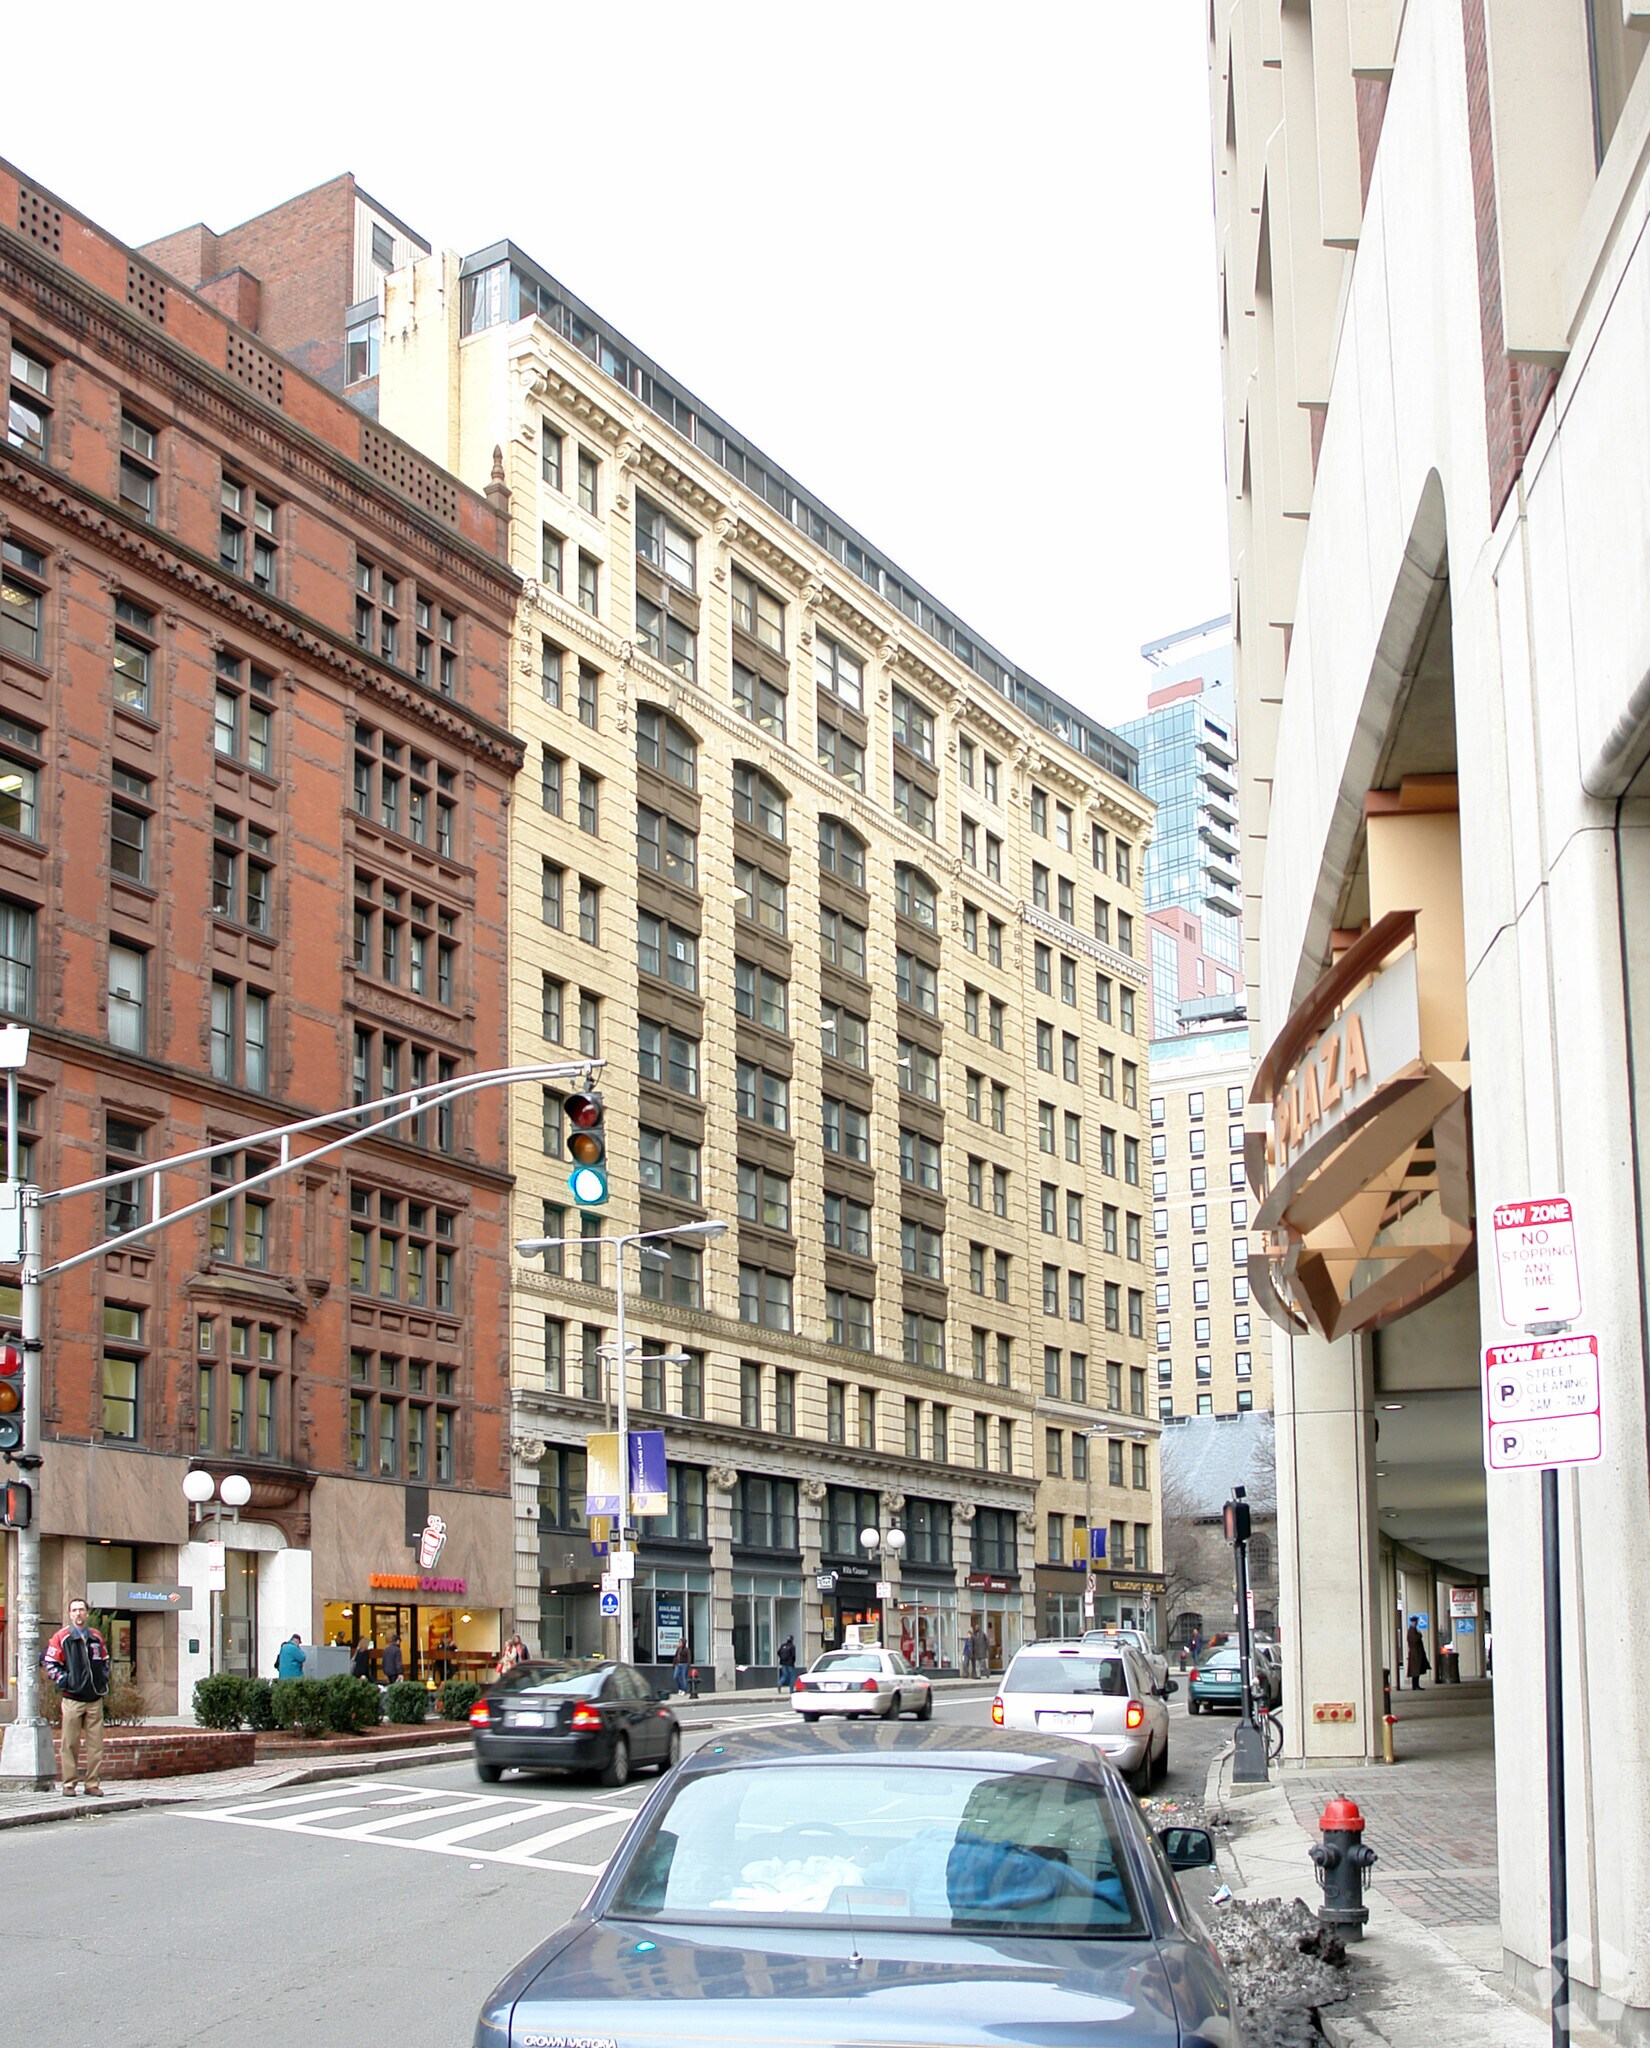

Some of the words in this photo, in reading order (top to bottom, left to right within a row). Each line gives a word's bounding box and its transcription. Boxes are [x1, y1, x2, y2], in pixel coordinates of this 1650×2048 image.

[1276, 1011, 1368, 1167] PLAZA
[1495, 1208, 1526, 1226] TOW
[1530, 1203, 1570, 1223] ZONE
[1522, 1230, 1548, 1246] NO
[1502, 1245, 1573, 1263] STOPPING
[1525, 1262, 1551, 1274] ANY
[1524, 1274, 1555, 1287] TIME
[1492, 1344, 1535, 1364] TOW
[1541, 1338, 1592, 1360] ZONE
[1526, 1364, 1573, 1380] STREET
[1526, 1377, 1588, 1395] CLEANING
[1530, 1398, 1551, 1412] 2AM
[1566, 1394, 1586, 1407] 7AM
[420, 1576, 467, 1593] DONUTS
[1454, 1591, 1474, 1601] AVIS
[523, 2034, 566, 2047] CROWN
[567, 2037, 617, 2048] VICTORIA
